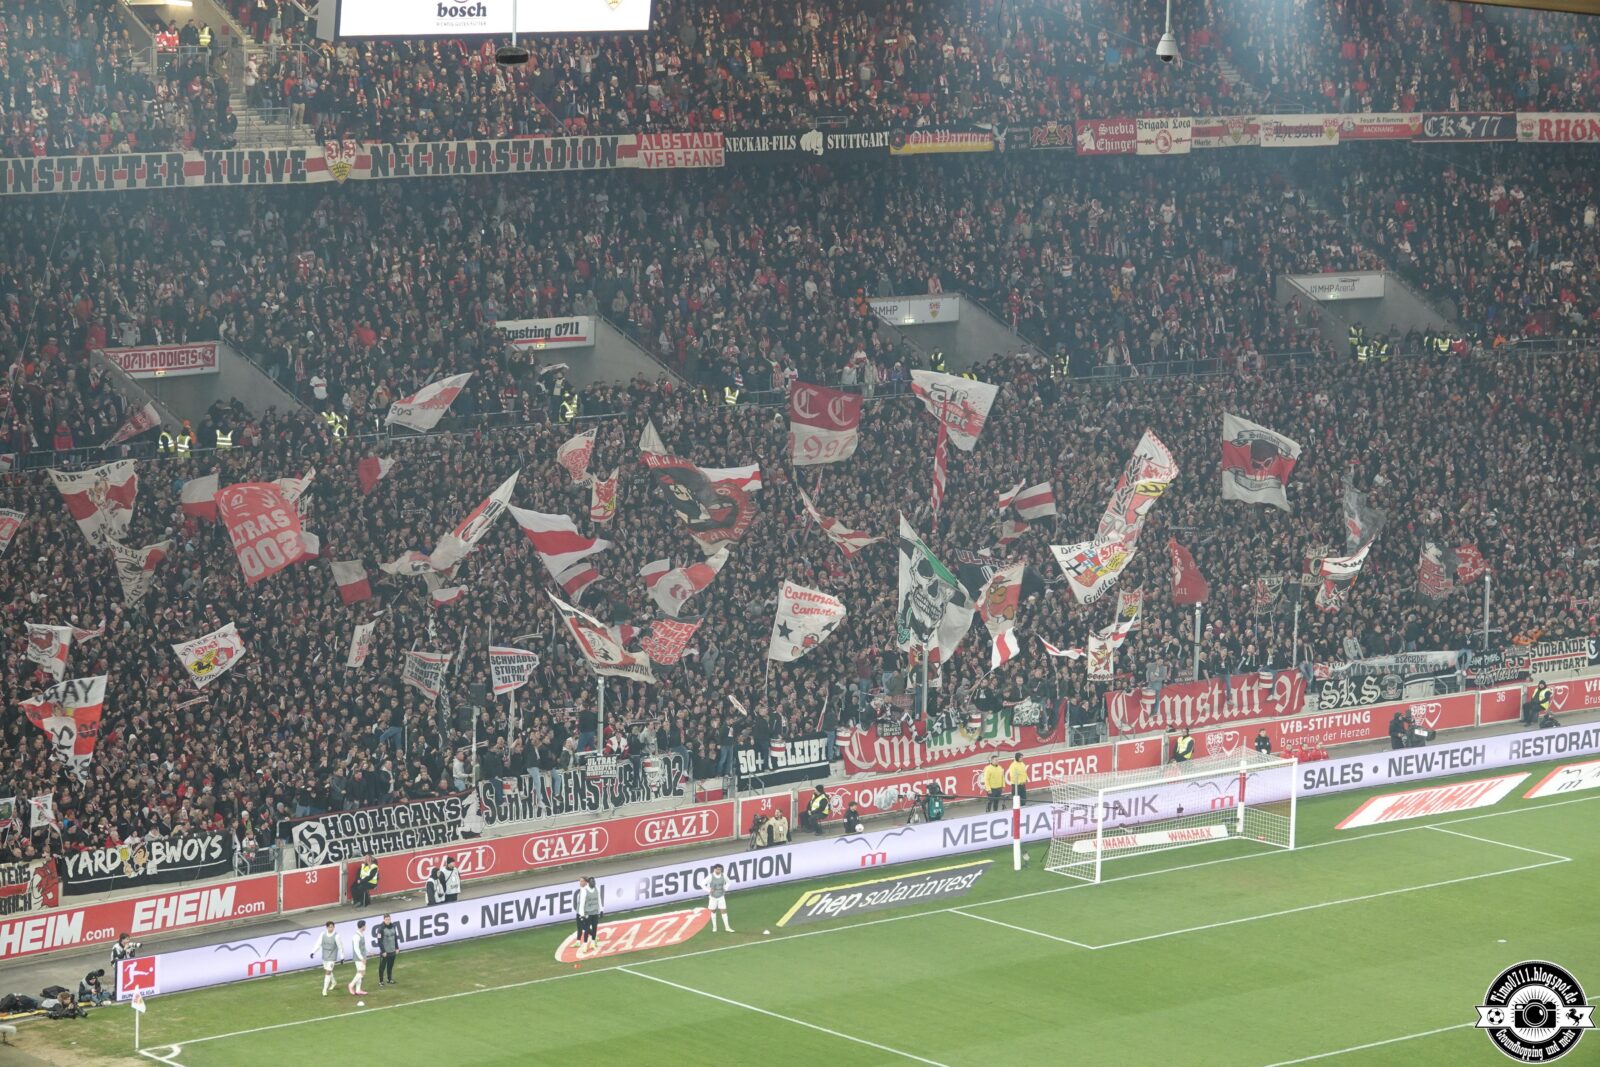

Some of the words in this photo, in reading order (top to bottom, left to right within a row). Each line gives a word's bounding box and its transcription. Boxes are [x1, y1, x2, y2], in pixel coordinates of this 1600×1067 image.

[437, 2, 487, 17] bosch
[1172, 118, 1190, 129] Loca
[1480, 115, 1502, 137] 77
[641, 132, 724, 150] ALBSTADT
[725, 134, 797, 153] NECKAR-FILS
[827, 131, 890, 149] STUTTGART
[370, 137, 618, 177] NECKARSTADION
[642, 149, 724, 169] VFB-FANS
[203, 150, 307, 185] KURVE
[555, 321, 580, 337] 0711
[494, 664, 524, 676] STURM
[1531, 656, 1586, 675] STUTTGART
[1496, 692, 1506, 703] 36
[1280, 711, 1372, 735] VfB-STIFTUNG
[1322, 731, 1337, 742] der
[1340, 727, 1371, 739] Herzen
[1134, 742, 1145, 754] 35
[1303, 762, 1364, 790] SALES
[1387, 744, 1486, 778] NEW-TECH
[761, 798, 772, 811] 34
[320, 798, 461, 841] HOOLIGANS
[1168, 827, 1212, 842] WINAMAX
[328, 824, 458, 864] STUTTGART
[65, 846, 121, 879] YARD
[151, 834, 223, 865] BWOYS
[305, 870, 318, 885] 33
[635, 852, 792, 900] RESTOATION
[807, 891, 863, 917] hep
[860, 869, 983, 907] solarinvest
[121, 990, 155, 1000] BUNSLIGA
